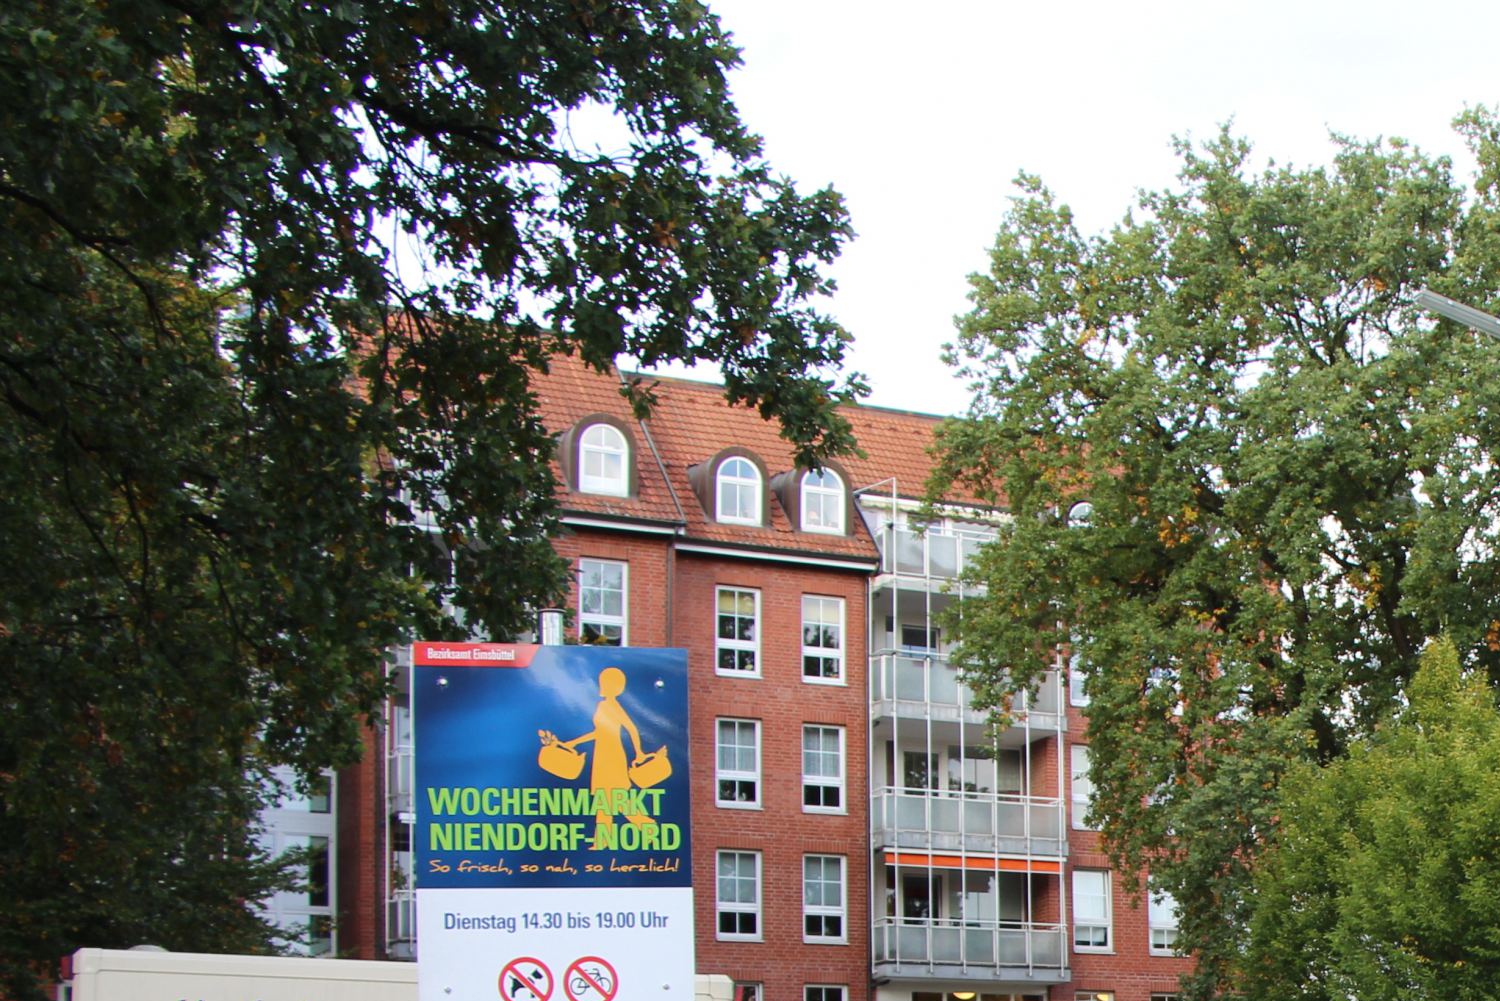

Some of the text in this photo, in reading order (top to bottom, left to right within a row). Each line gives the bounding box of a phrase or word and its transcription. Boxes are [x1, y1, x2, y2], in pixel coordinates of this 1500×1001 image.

[427, 648, 515, 661] Bezirksamt Eimsbüttel
[427, 787, 666, 816] WOCHENMARKT
[430, 822, 682, 851] NIENDORF-NORD
[429, 858, 680, 875] So frisch, so nah, so herzlich!
[444, 911, 669, 933] Dienstag 14.30 bis 19.00 Uhr
